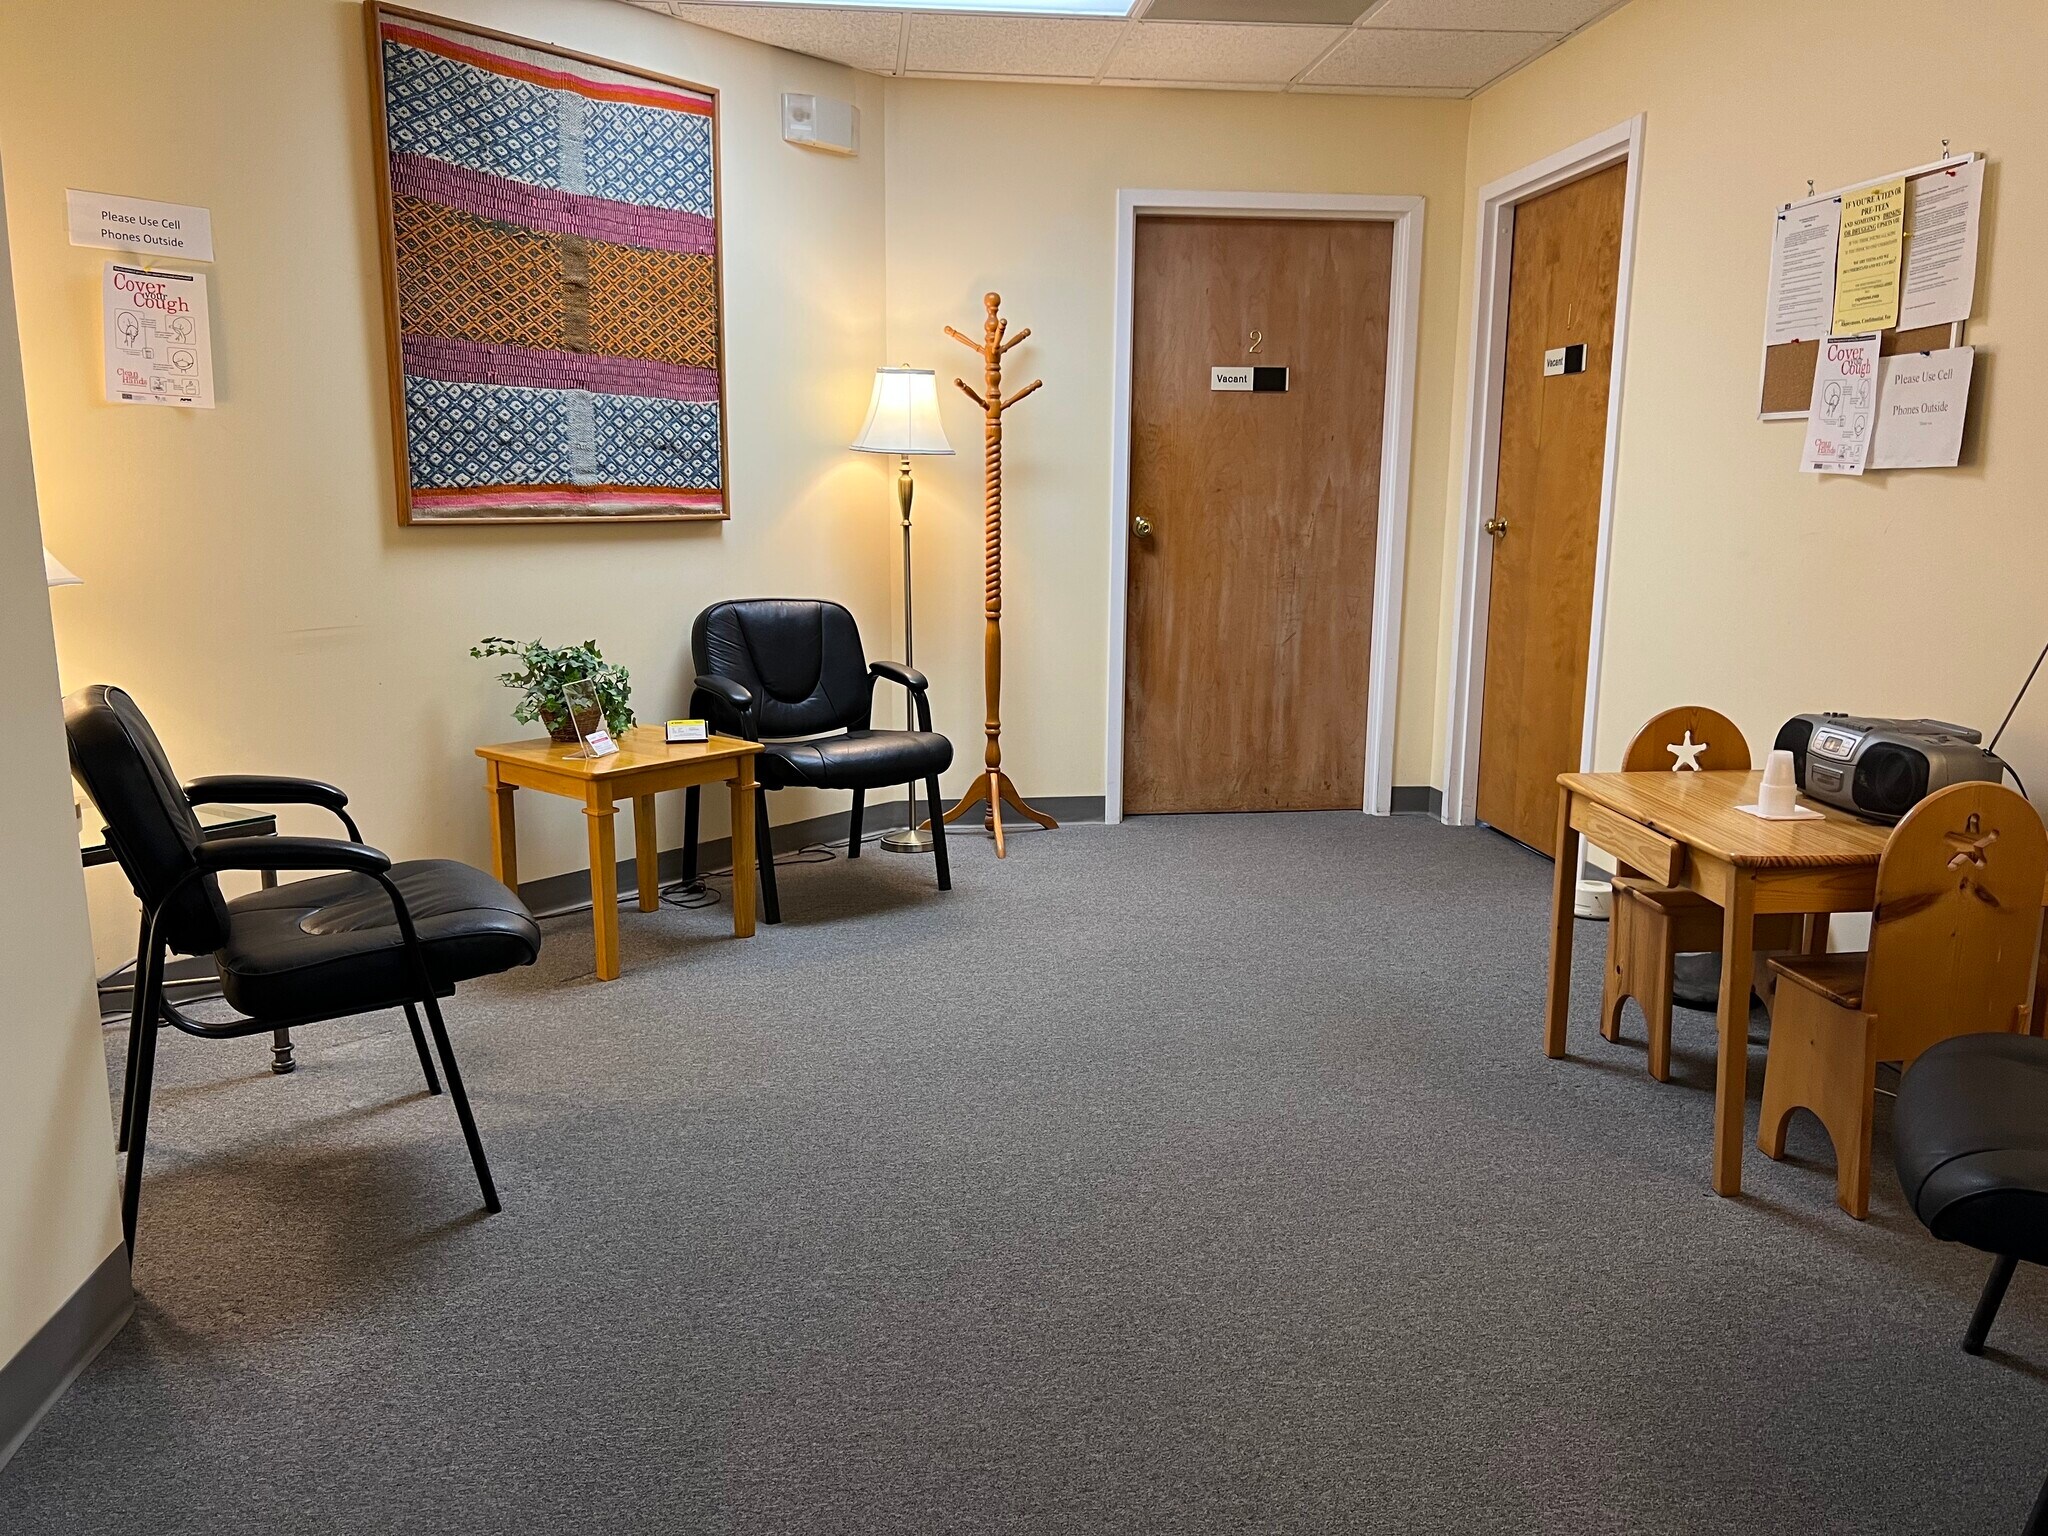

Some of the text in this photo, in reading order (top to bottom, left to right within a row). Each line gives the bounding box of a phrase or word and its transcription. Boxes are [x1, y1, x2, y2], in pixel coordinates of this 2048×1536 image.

[1852, 195, 1874, 208] YOU'RE
[1861, 202, 1890, 216] PRE-TEEN
[101, 210, 181, 230] Please Use Cell
[101, 228, 184, 248] Phones Outside
[114, 272, 166, 295] Cover
[133, 291, 189, 315] Cough
[1249, 329, 1263, 354] 2
[1827, 344, 1864, 362] Cover
[1546, 356, 1564, 368] Vacant
[1841, 359, 1871, 378] Cough
[116, 368, 139, 380] Clean
[122, 375, 148, 386] Hands
[1216, 374, 1248, 384] Vacant
[1894, 368, 1954, 385] Please Use Cell
[1892, 401, 1949, 416] Phones Outside
